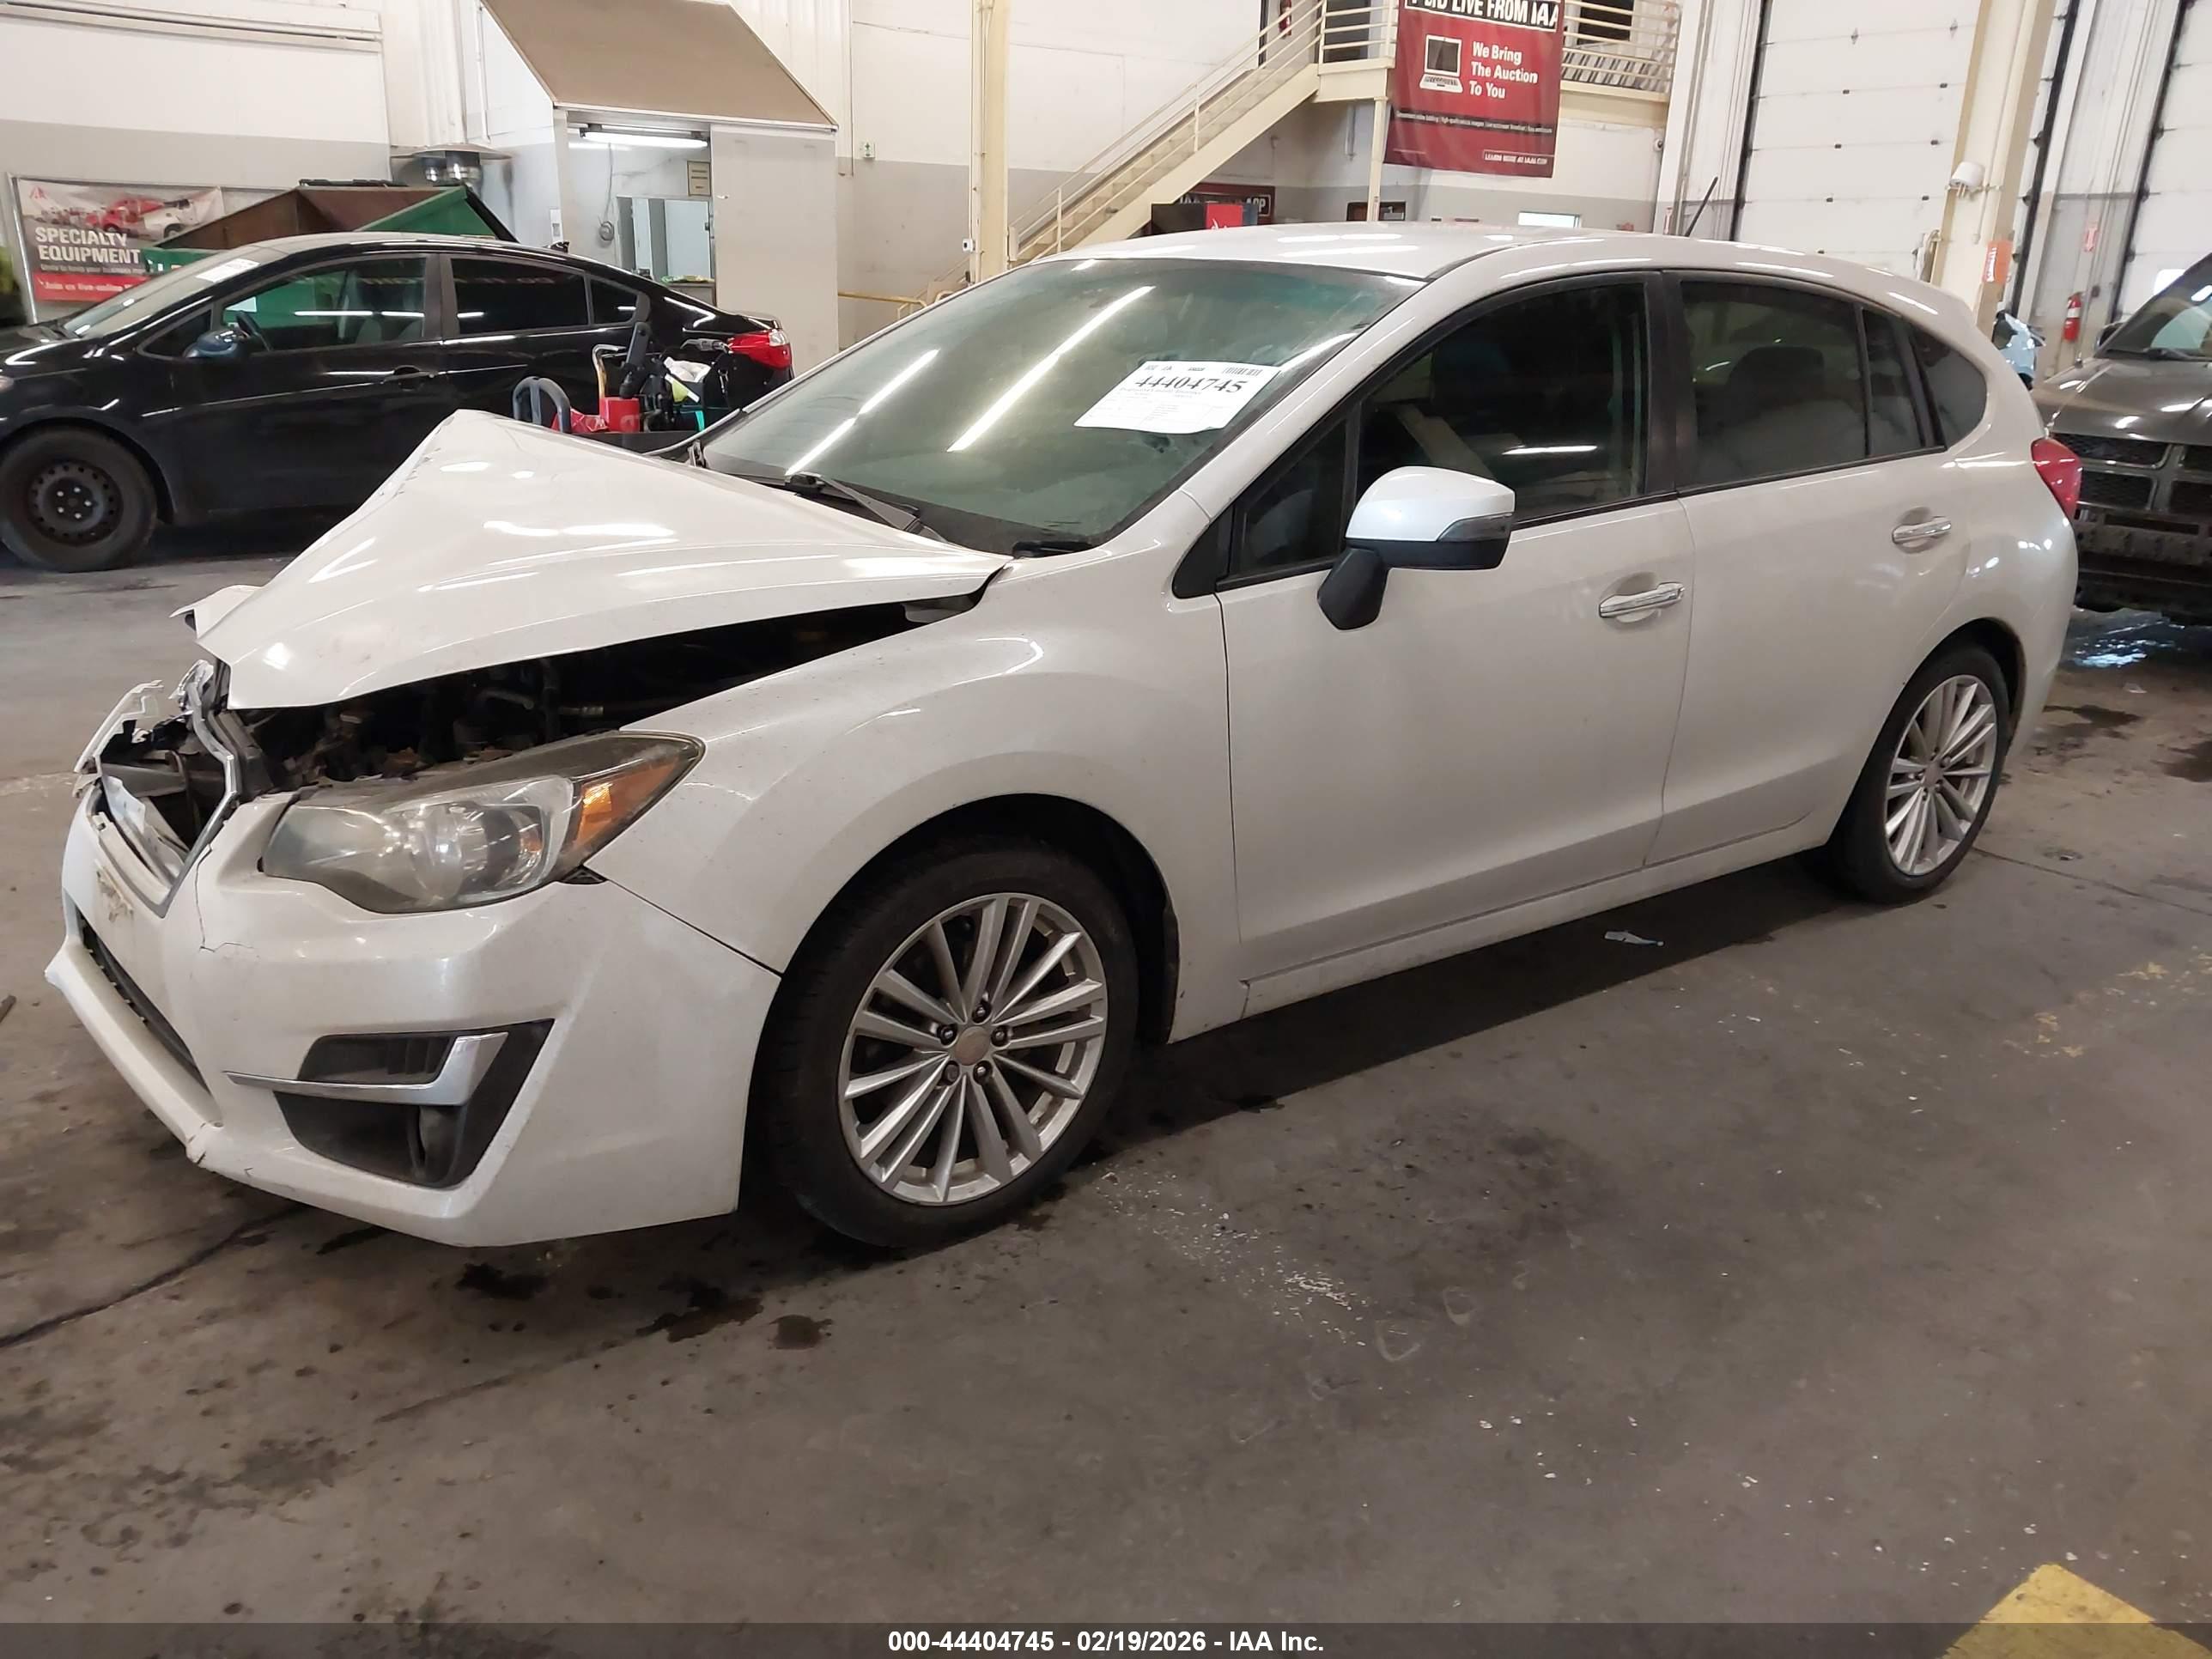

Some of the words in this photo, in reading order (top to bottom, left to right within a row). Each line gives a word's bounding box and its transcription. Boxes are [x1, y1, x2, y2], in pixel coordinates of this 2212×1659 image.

[1452, 0, 1484, 15] LIVE
[1486, 0, 1528, 23] FROM
[1473, 40, 1490, 58] We
[1492, 44, 1522, 66] Bring
[1471, 61, 1492, 77] The
[1493, 64, 1539, 84] Auction
[1469, 80, 1483, 96] To
[1486, 82, 1506, 99] You
[35, 227, 127, 246] SPECIALTY
[38, 245, 141, 264] EQUIPMENT
[1134, 375, 1249, 393] 44404745
